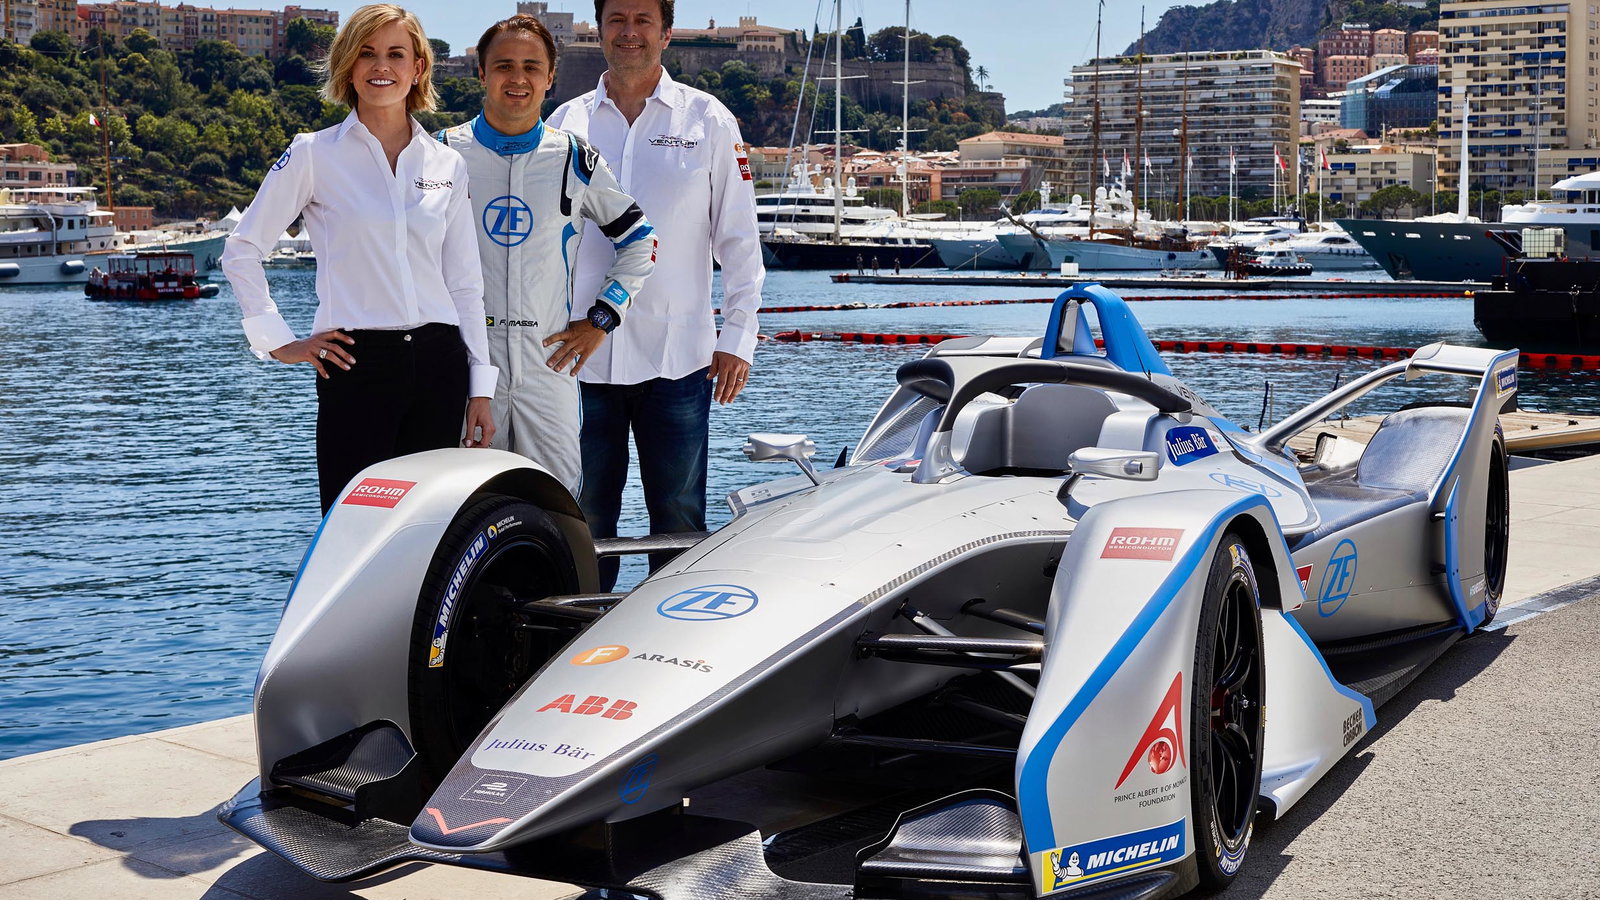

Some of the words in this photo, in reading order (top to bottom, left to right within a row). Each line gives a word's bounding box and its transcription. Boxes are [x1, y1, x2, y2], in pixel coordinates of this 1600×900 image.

[648, 138, 698, 146] VENTURI
[486, 203, 531, 239] ZF
[508, 320, 539, 328] MASSA
[1174, 384, 1210, 407] VENTU
[1166, 438, 1195, 462] Julius
[1190, 433, 1208, 450] Bär
[355, 485, 405, 496] ROHM
[496, 515, 515, 529] MICHELIN
[1110, 536, 1175, 546] ROHM
[438, 536, 485, 628] MICHELIN
[1321, 551, 1357, 606] ZF
[660, 588, 757, 619] ZF
[535, 694, 638, 720] ABB
[483, 738, 548, 752] Julius
[551, 743, 596, 760] Bär
[622, 756, 657, 798] ZF
[1114, 793, 1136, 803] PRINCE
[1137, 787, 1159, 798] ALBERT
[1164, 784, 1172, 792] OF
[1138, 793, 1176, 808] FOUNDATION
[1086, 834, 1180, 870] MICHELIN
